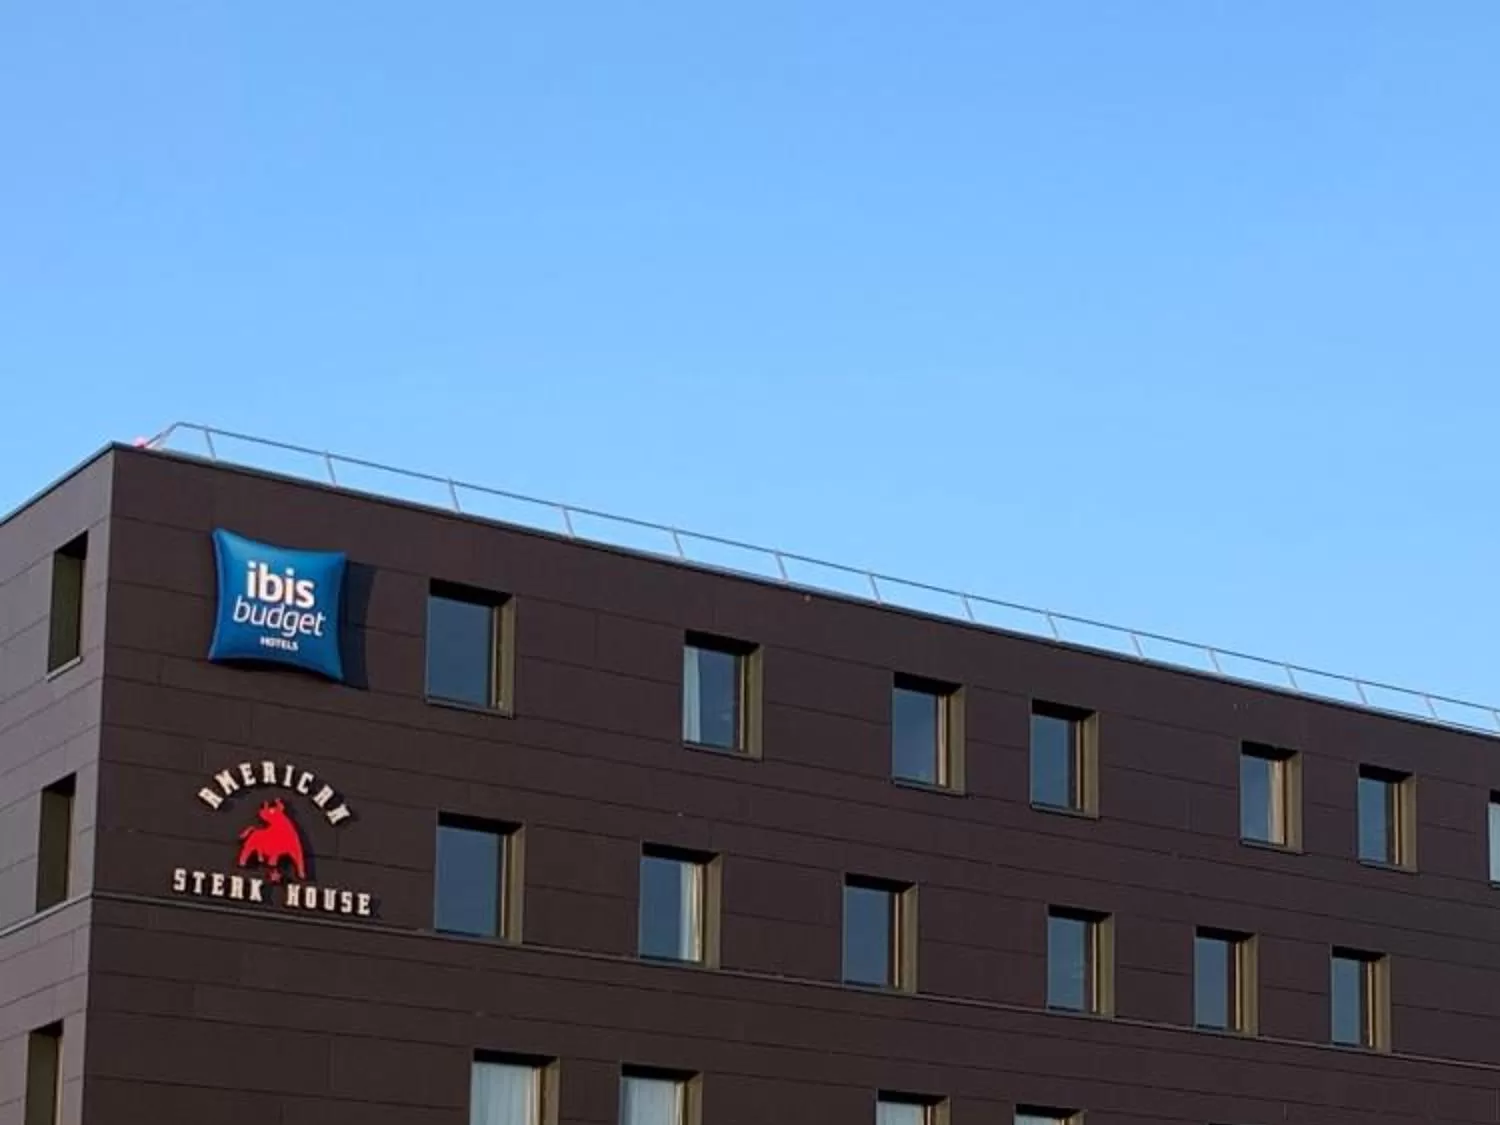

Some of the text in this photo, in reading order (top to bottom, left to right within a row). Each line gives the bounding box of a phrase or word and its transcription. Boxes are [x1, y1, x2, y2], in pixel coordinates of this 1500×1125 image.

[247, 561, 315, 608] ibis
[233, 595, 327, 637] budget
[260, 637, 299, 651] HOTELS
[197, 760, 351, 825] AMERICAN
[173, 867, 372, 916] STEAK HOUSE
